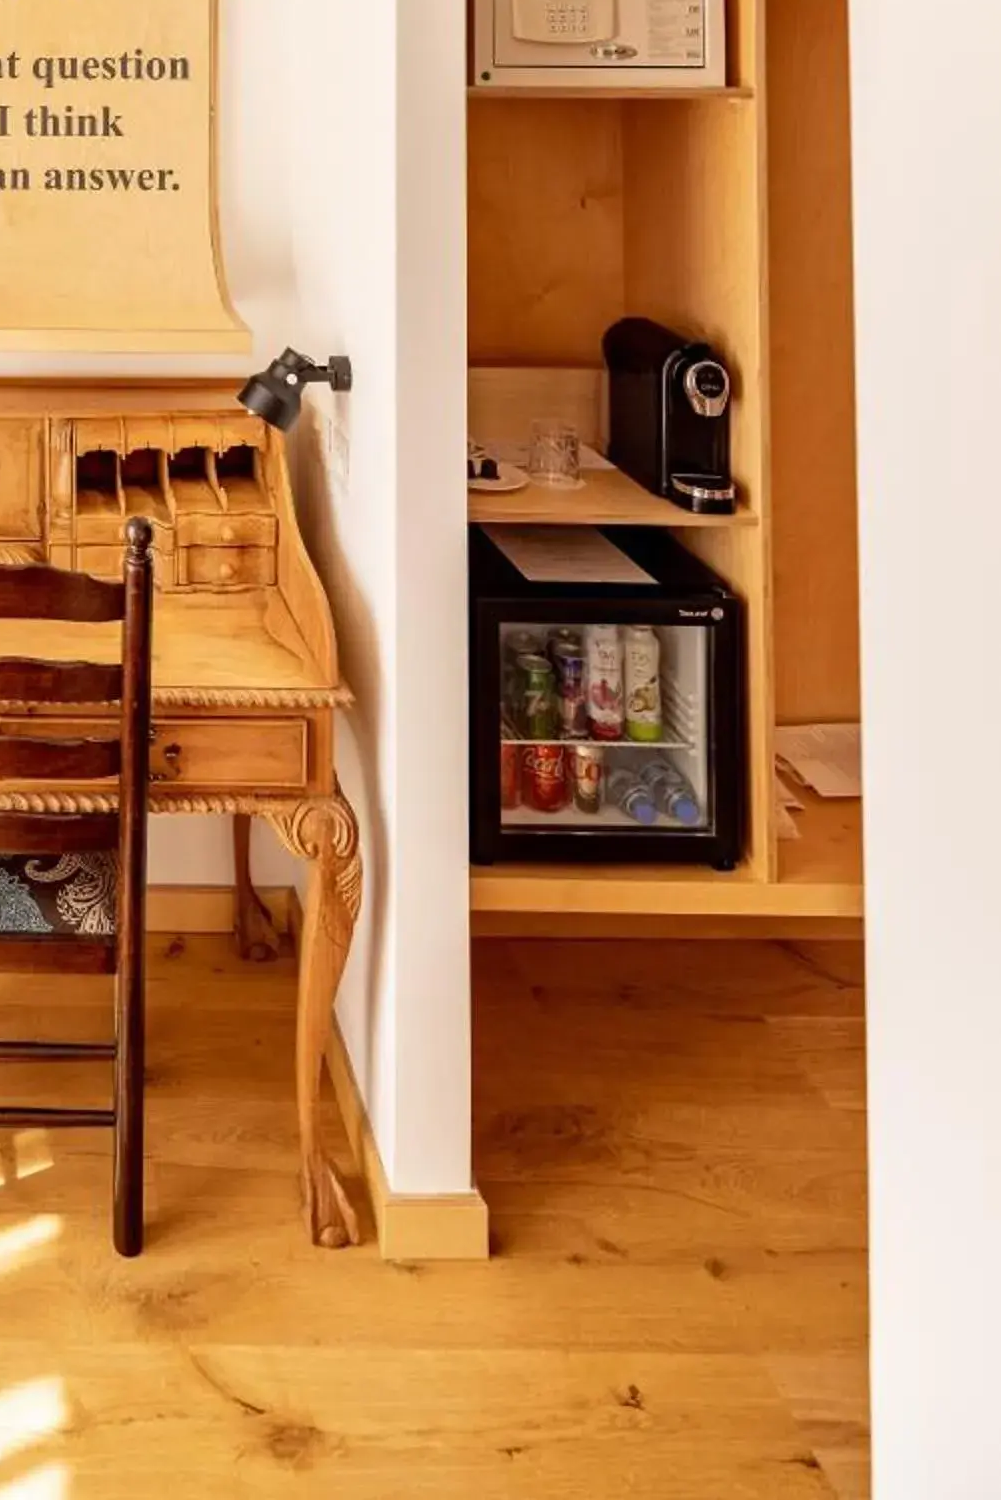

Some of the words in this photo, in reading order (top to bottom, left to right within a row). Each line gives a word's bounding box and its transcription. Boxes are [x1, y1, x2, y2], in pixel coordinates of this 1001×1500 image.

[32, 48, 190, 89] question
[24, 105, 124, 137] think
[44, 168, 180, 192] answer.
